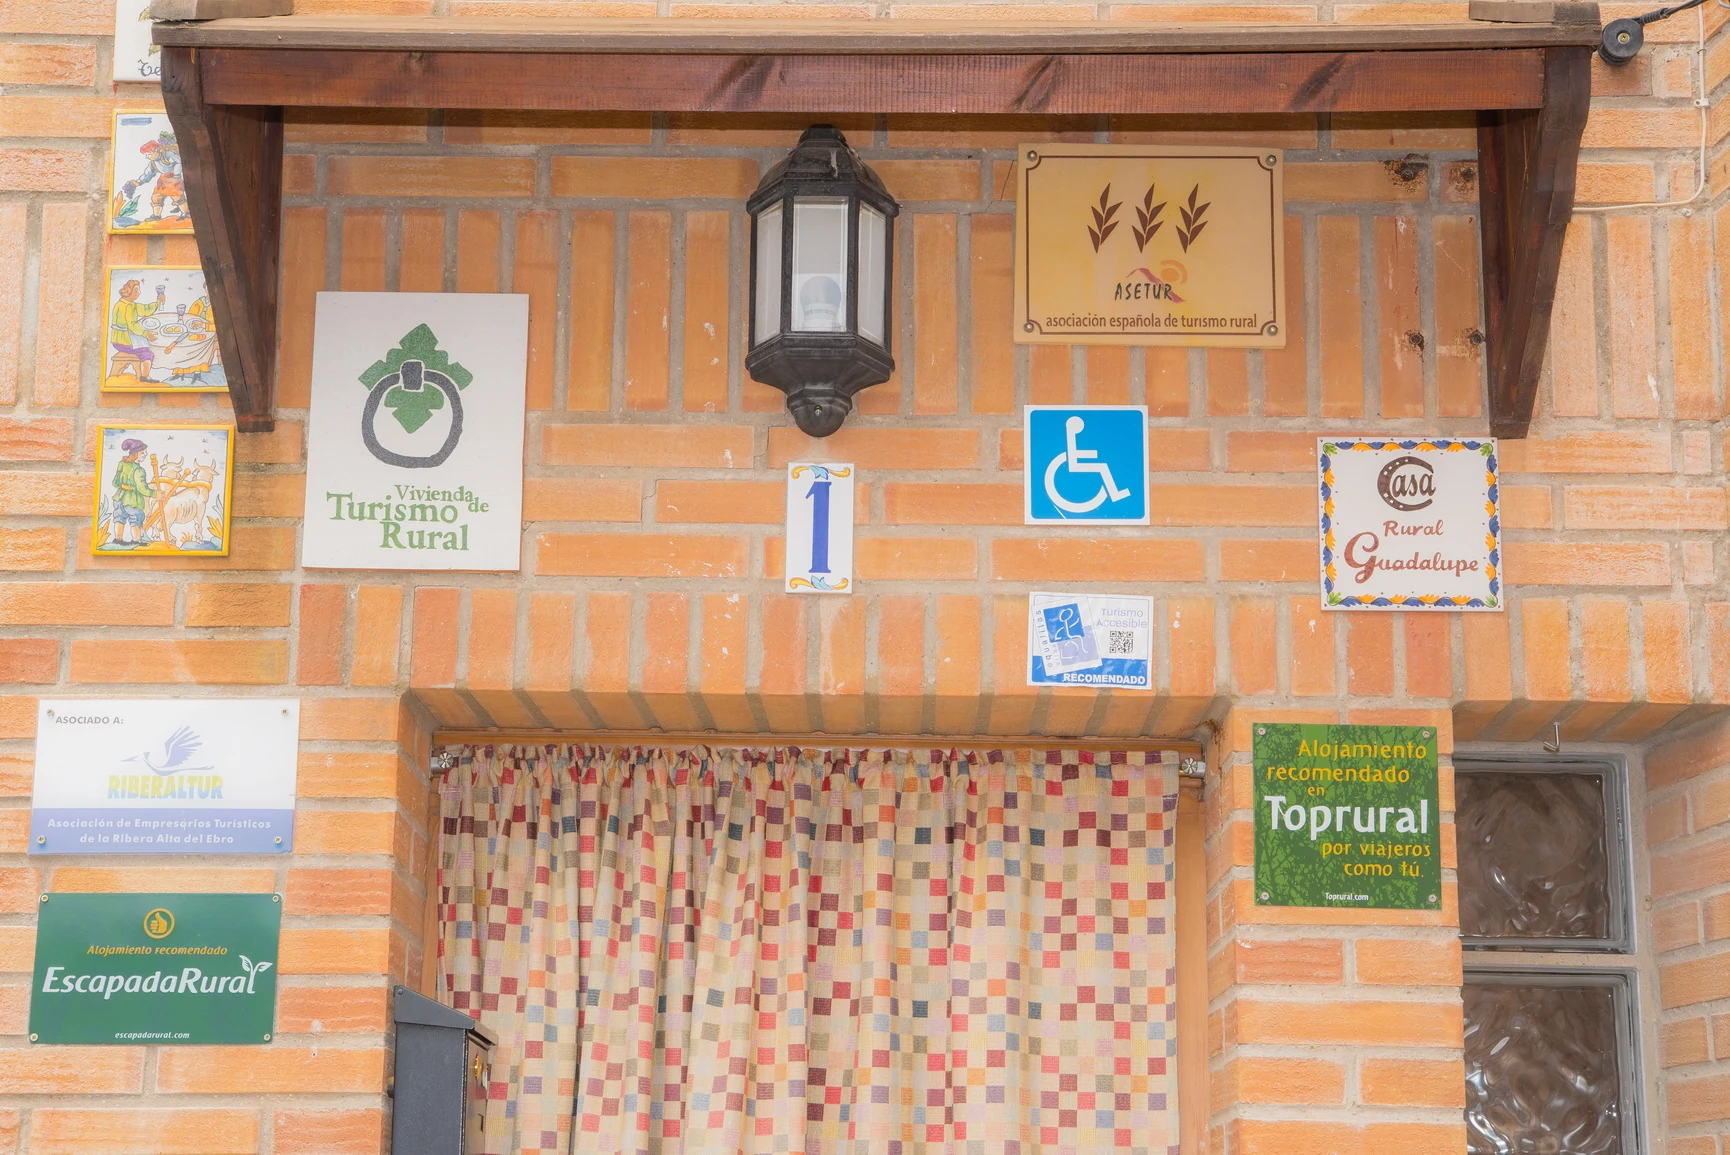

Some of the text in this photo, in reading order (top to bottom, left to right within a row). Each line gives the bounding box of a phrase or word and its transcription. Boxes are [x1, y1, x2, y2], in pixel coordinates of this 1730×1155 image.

[1115, 283, 1173, 301] ASETUR
[1046, 313, 1257, 331] asociación española de turismo rural
[1377, 456, 1436, 512] Casa
[394, 484, 474, 503] Vivienda
[326, 491, 459, 524] Turismo
[467, 497, 489, 514] de
[805, 481, 832, 573] 1
[1383, 520, 1444, 537] Rural
[379, 522, 470, 551] Rural
[1344, 531, 1479, 584] Guadalupe
[1101, 608, 1144, 618] Turismo
[1096, 619, 1148, 629] Accesible
[1062, 673, 1146, 685] RECOMENDADO
[55, 716, 124, 725] ASOCIADO A:
[1297, 739, 1427, 761] Alojamiento
[1267, 765, 1410, 783] recomendado
[107, 775, 224, 799] RIBERALTUR
[1307, 786, 1325, 796] en
[47, 818, 272, 830] Asociación de Empresarios Turísticos
[1264, 795, 1428, 841] Toprural
[79, 834, 234, 844] de la Ribera Alta del Ebro
[1321, 841, 1431, 860] por viajeros
[1343, 860, 1424, 878] como tú.
[1325, 892, 1369, 902] Toprural.com
[86, 945, 228, 957] Alojamiento recomendado
[42, 957, 268, 1000] EscapadaRural
[115, 1031, 190, 1041] escapadarural.com
